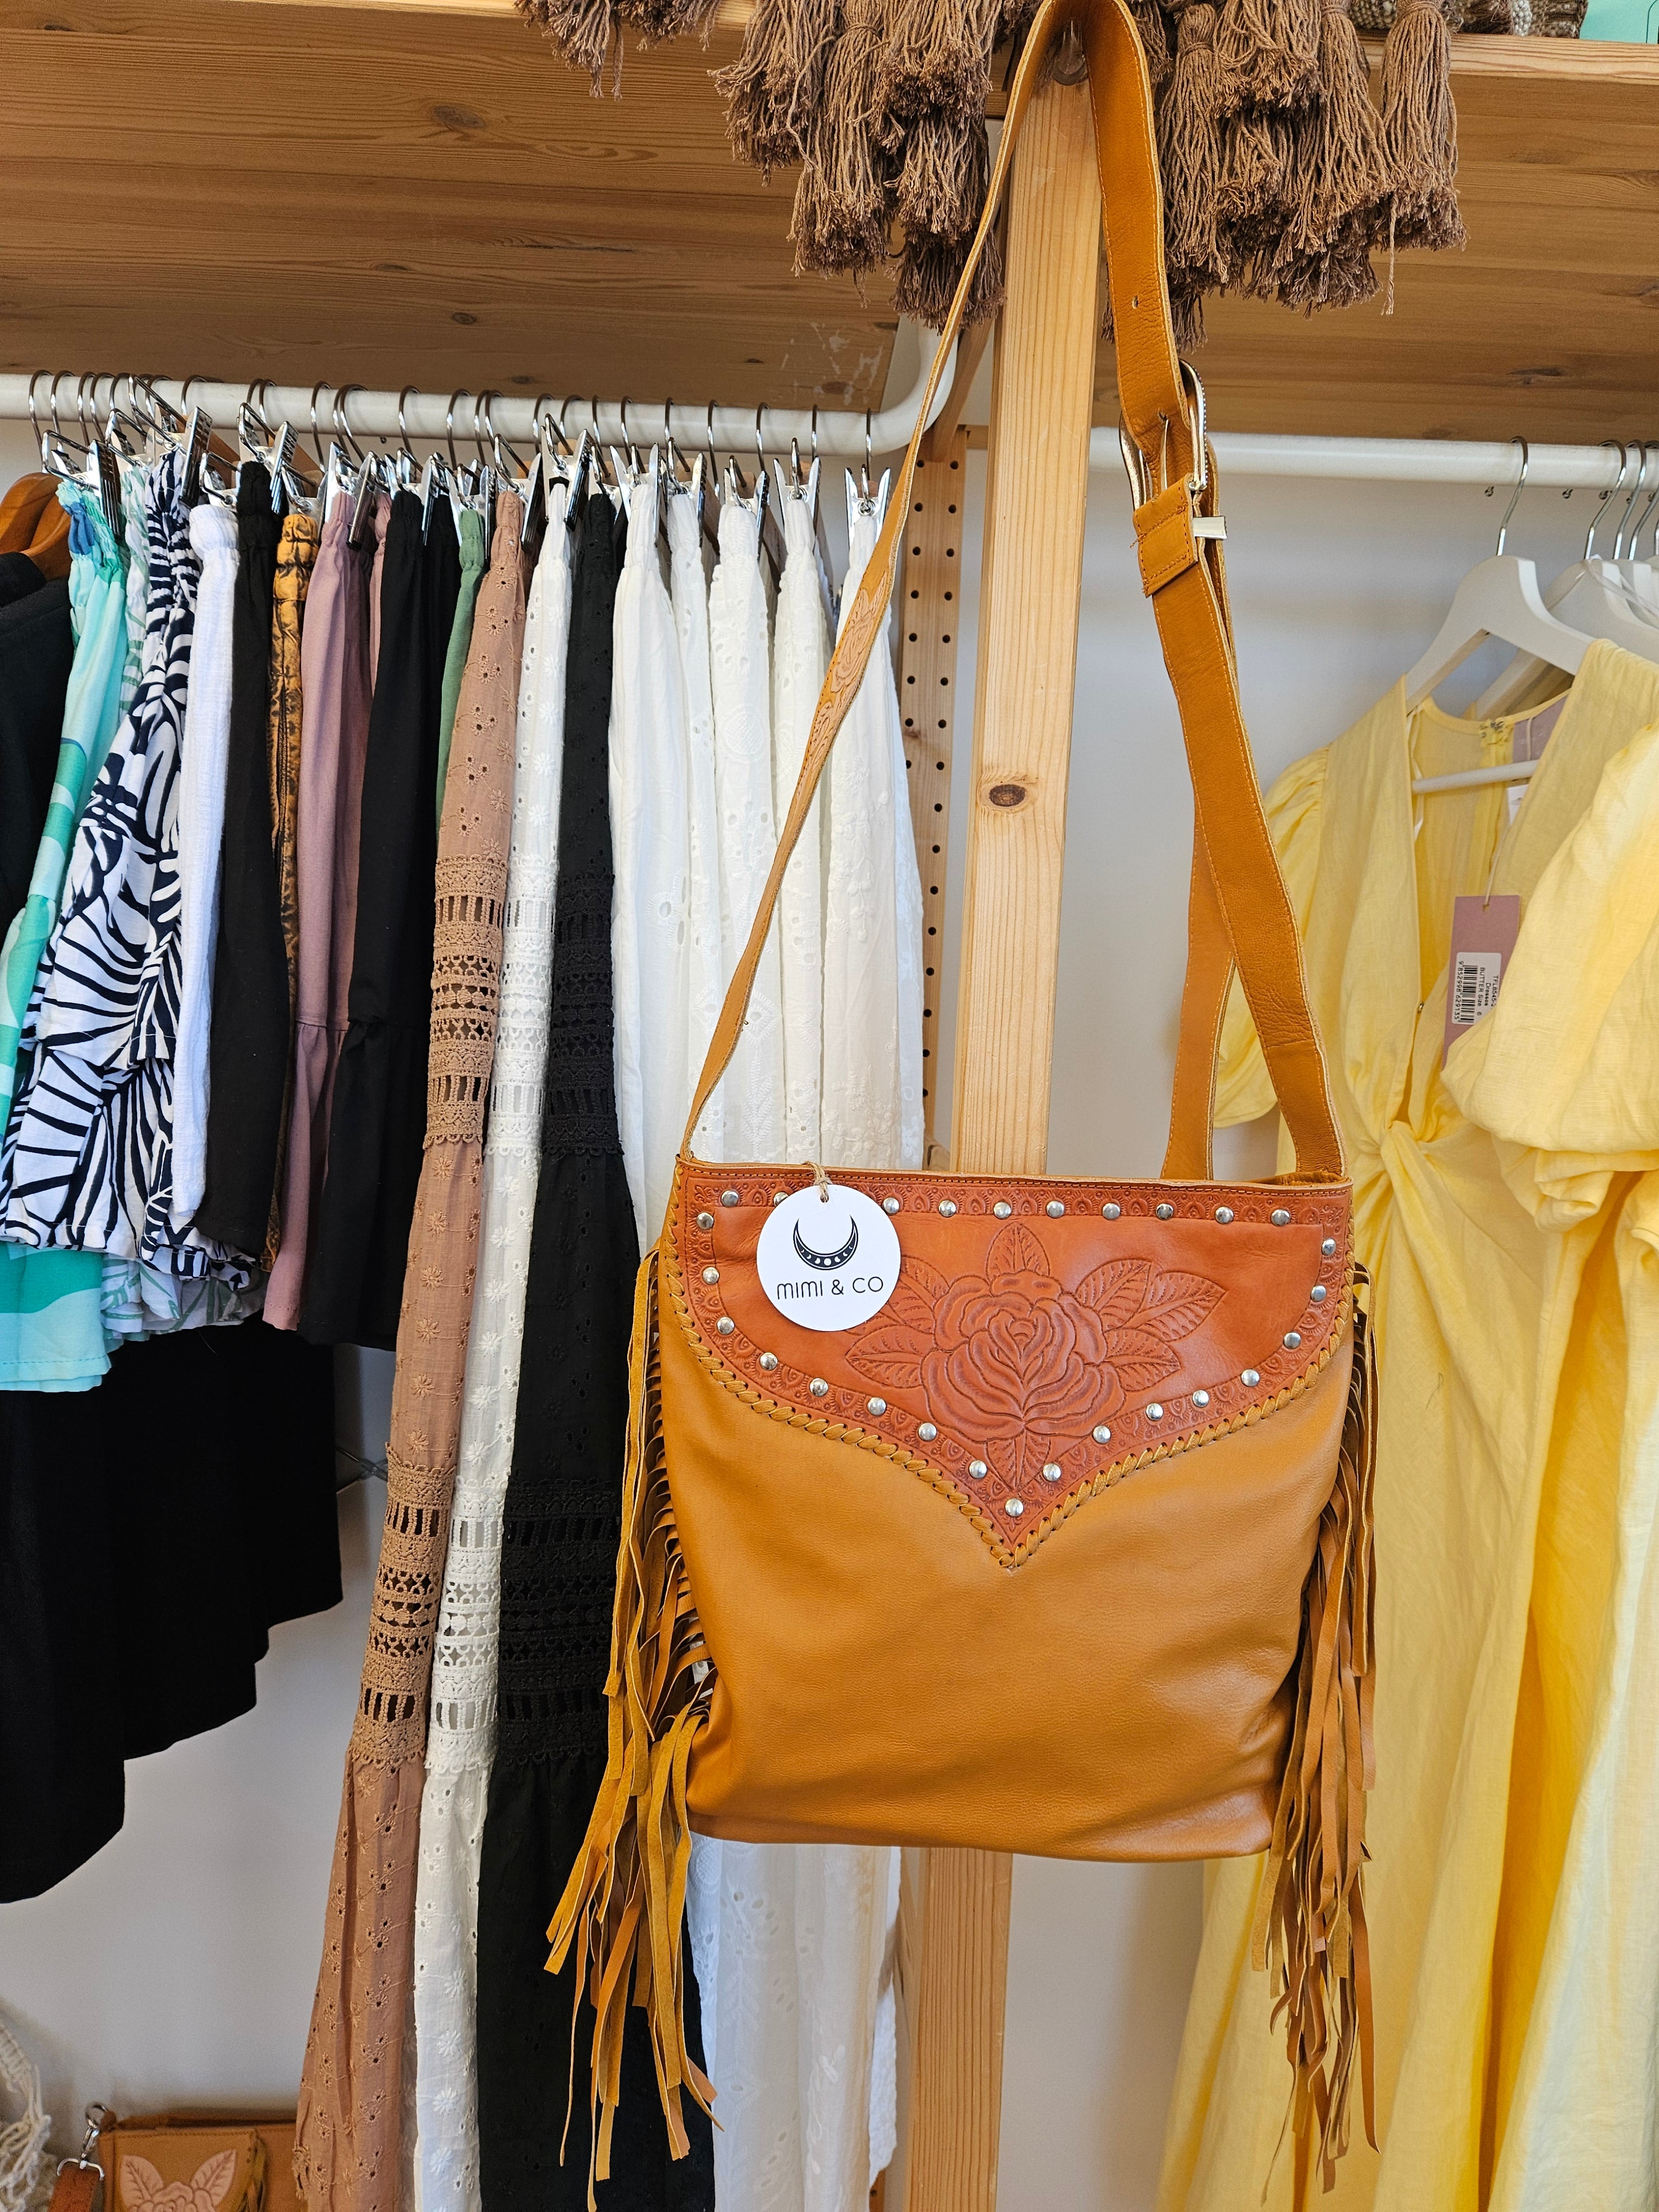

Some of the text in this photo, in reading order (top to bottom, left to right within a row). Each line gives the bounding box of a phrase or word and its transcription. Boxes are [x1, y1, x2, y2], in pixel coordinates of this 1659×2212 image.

[777, 1276, 884, 1300] MIMI & CO
